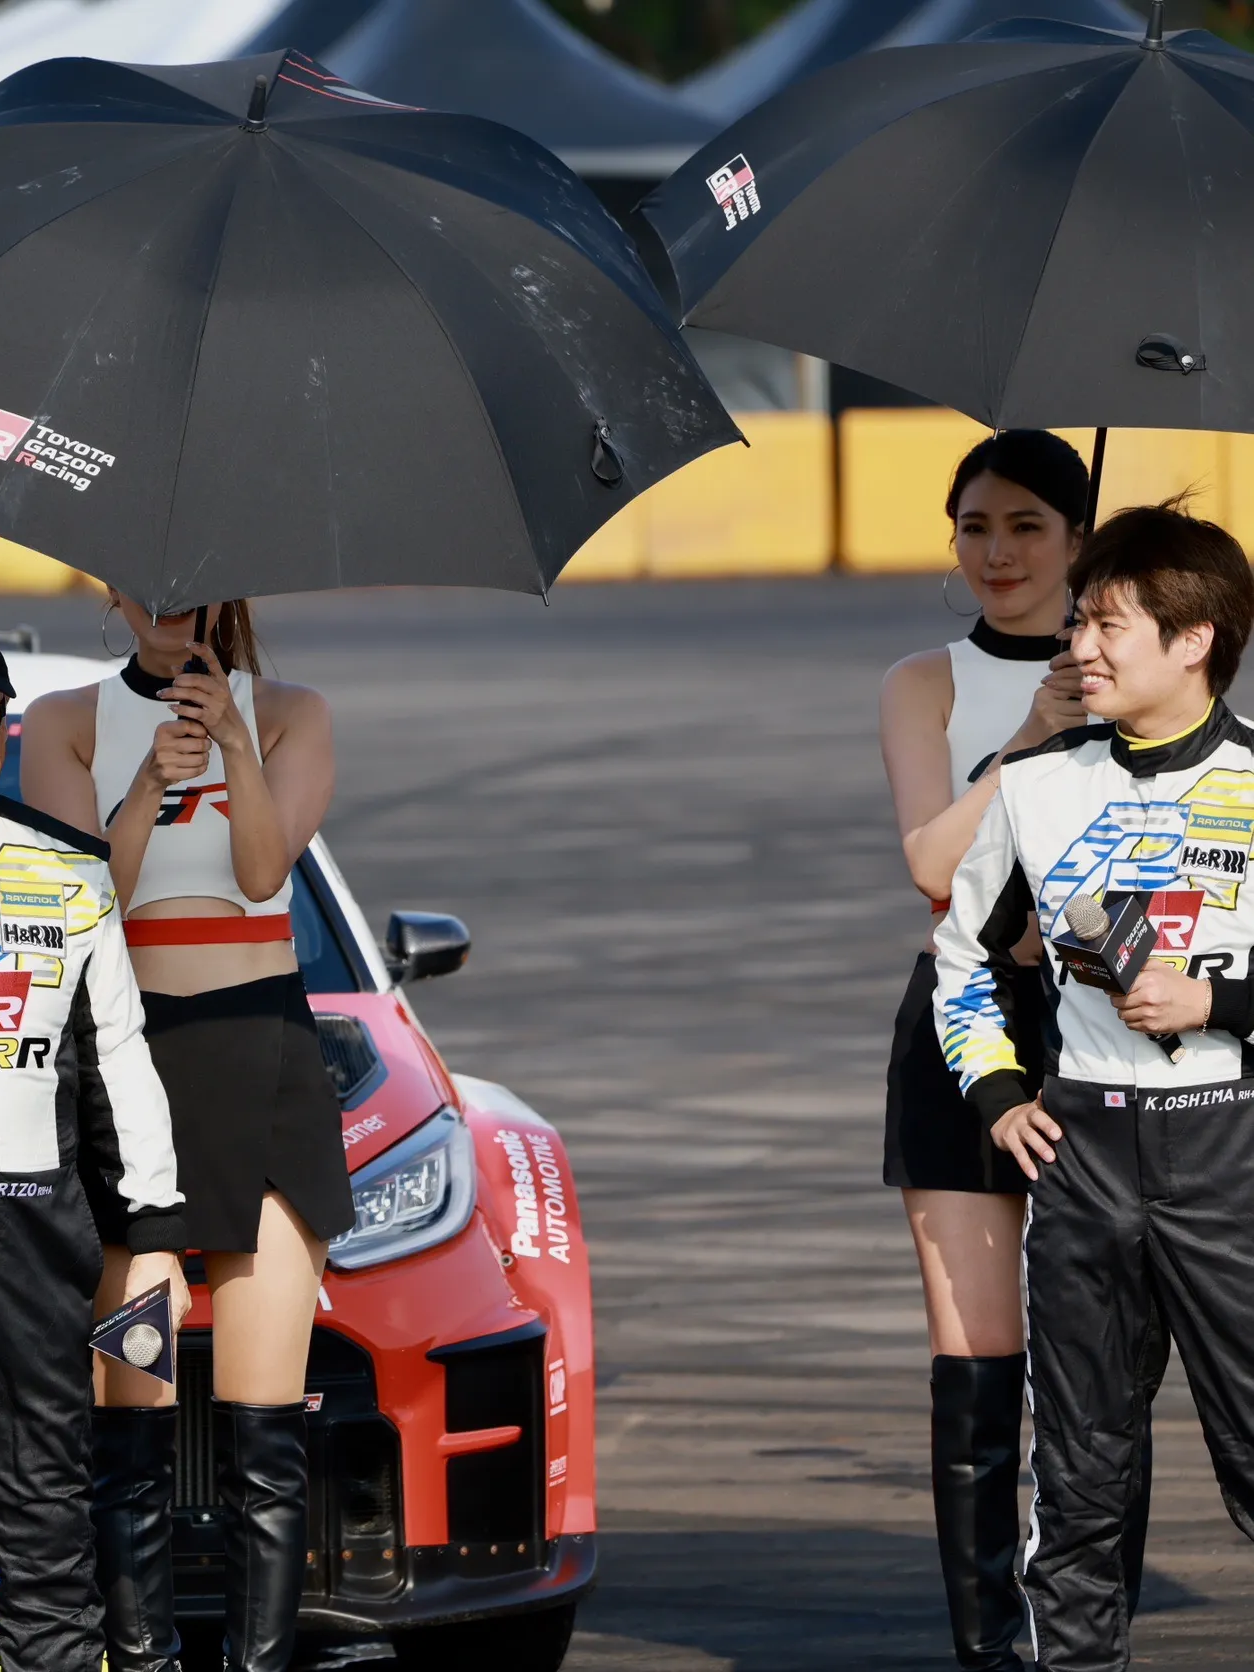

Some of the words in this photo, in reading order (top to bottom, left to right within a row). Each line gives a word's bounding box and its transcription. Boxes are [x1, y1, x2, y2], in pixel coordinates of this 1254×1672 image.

[721, 198, 738, 231] Racing
[733, 190, 749, 220] GAZOO
[745, 180, 761, 215] TOYOTA
[23, 438, 101, 477] GAZOO
[36, 425, 116, 467] TOYOTA
[14, 450, 91, 492] Racing
[1197, 818, 1247, 828] RAVENOL
[6, 894, 57, 904] RAVENOL
[1124, 915, 1144, 947] GAZOO
[1148, 915, 1195, 949] R
[1145, 1088, 1234, 1111] K.OSHIMA
[494, 1129, 541, 1258] Panasonic
[526, 1133, 571, 1264] AUTOMOTIVE
